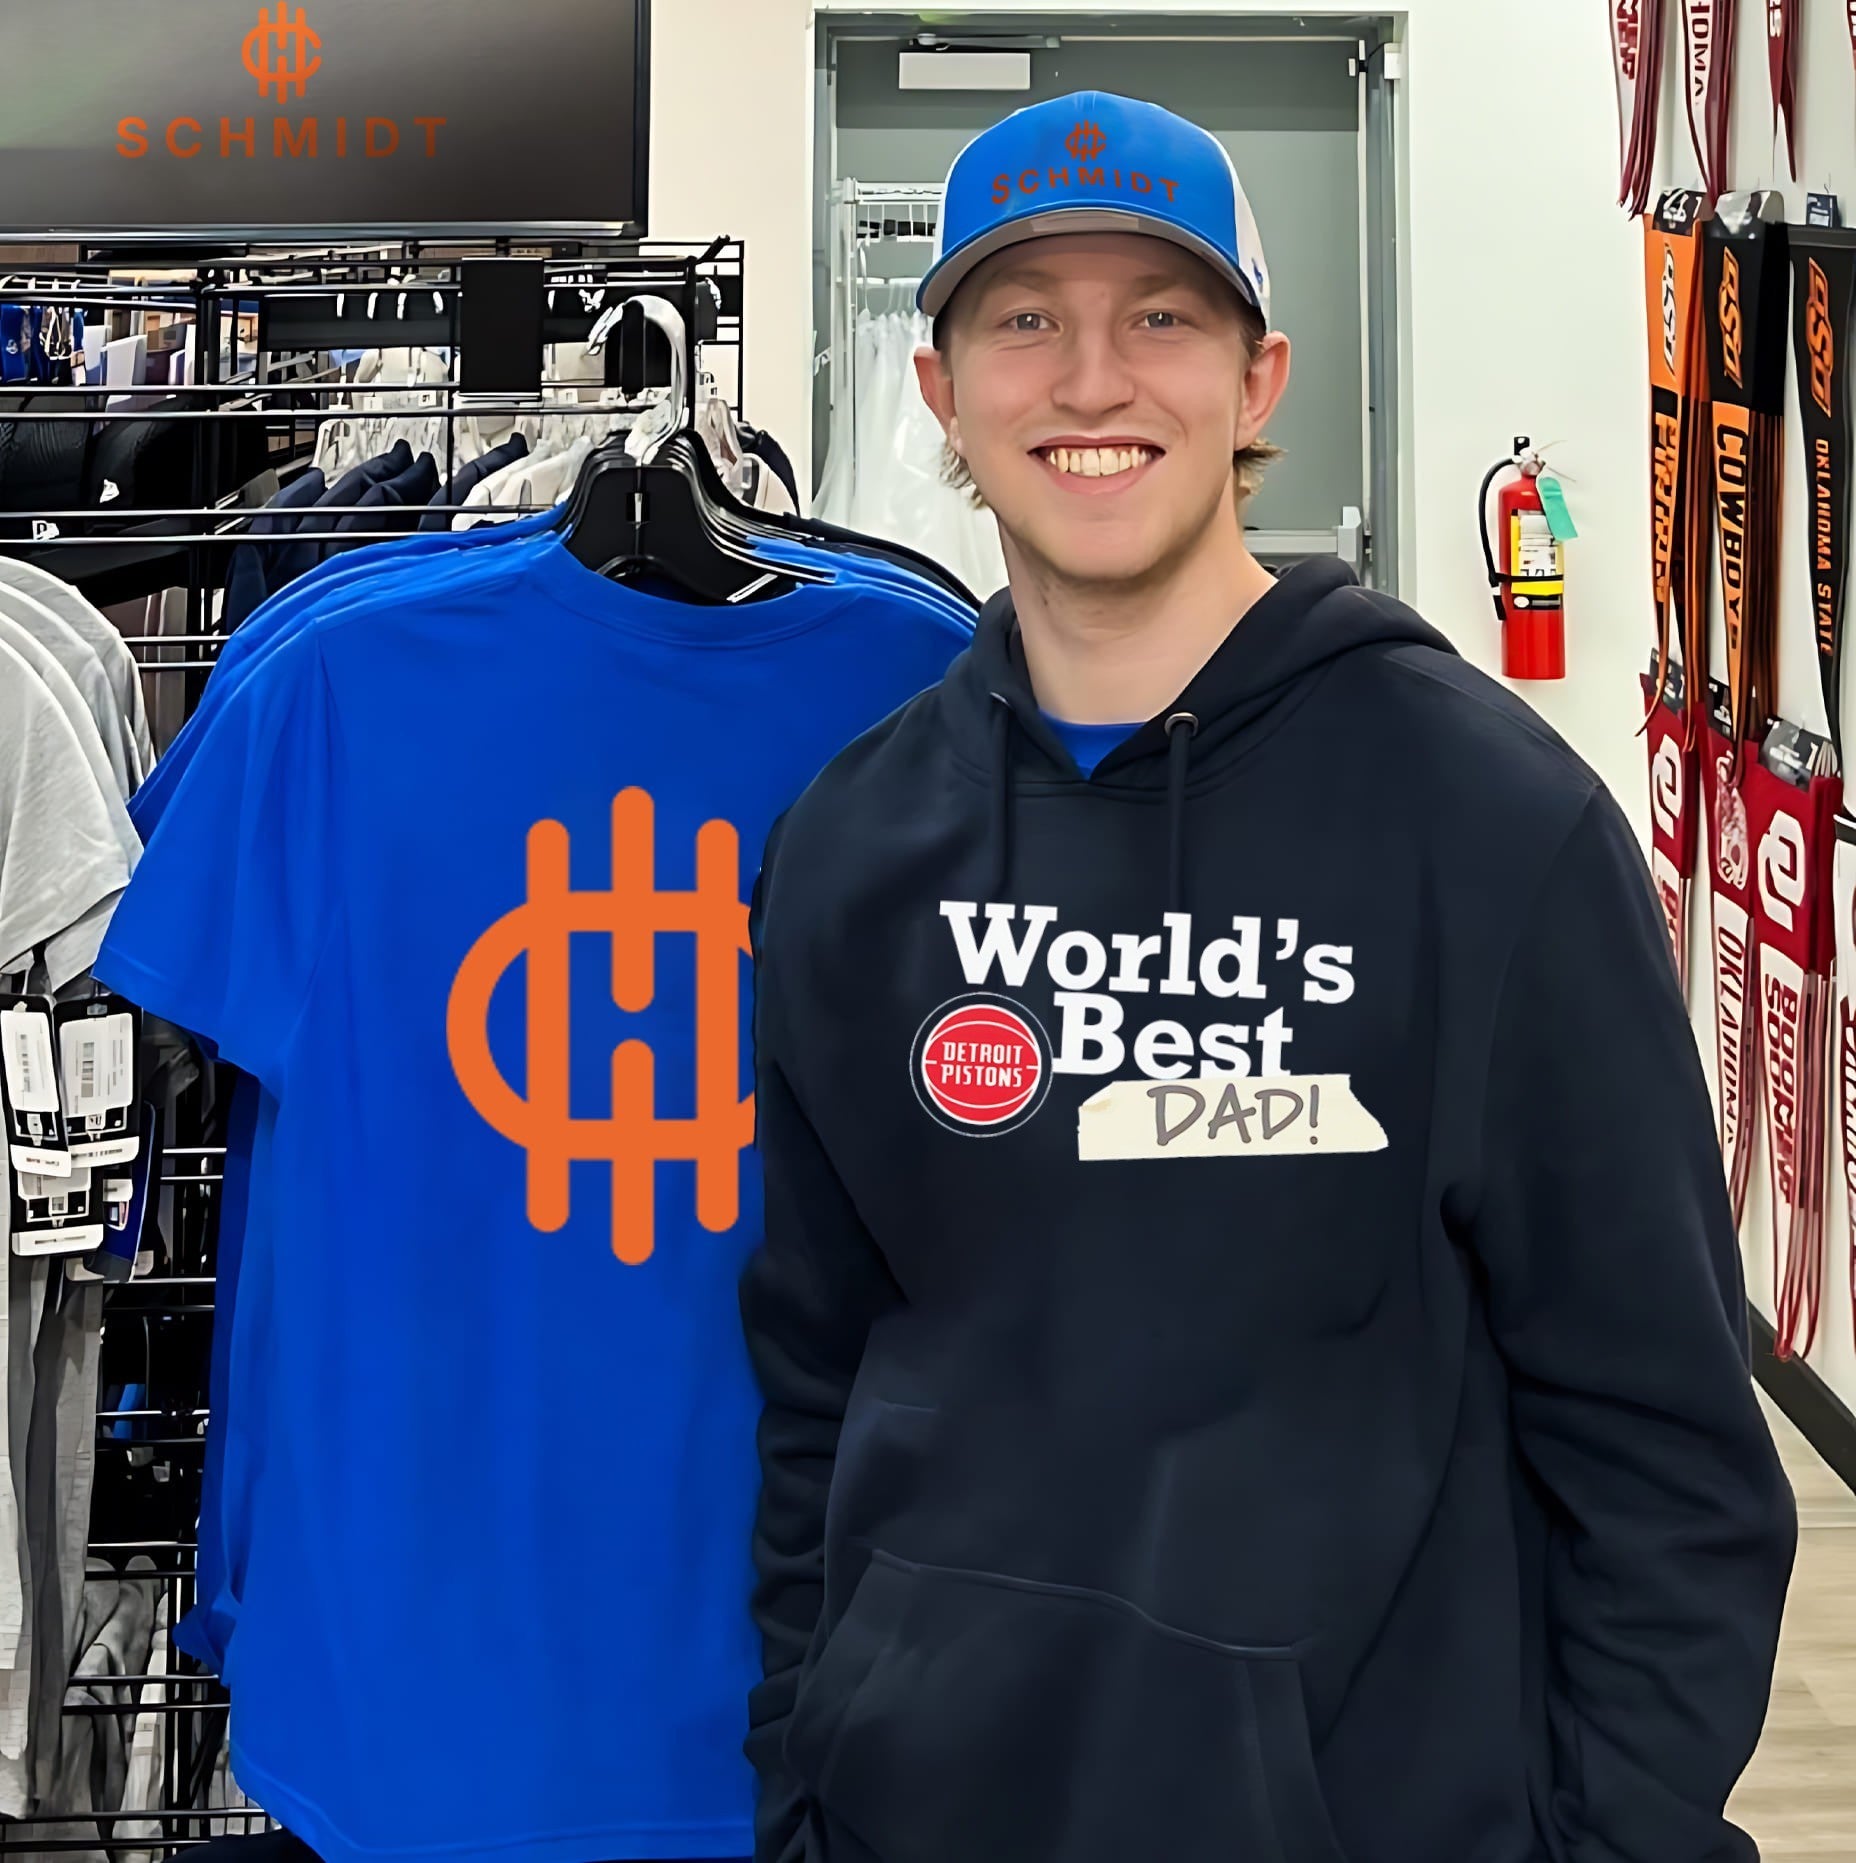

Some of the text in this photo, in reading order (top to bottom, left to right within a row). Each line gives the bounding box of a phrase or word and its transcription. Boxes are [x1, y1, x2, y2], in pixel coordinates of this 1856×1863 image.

[1691, 0, 1710, 97] OMA
[116, 117, 447, 159] SCHMIDT
[991, 167, 1179, 205] SCHMIDT
[1815, 438, 1834, 657] OKLAHOMA STATE
[940, 900, 1355, 1005] World's
[942, 1041, 1023, 1065] DETROIT
[1053, 991, 1293, 1080] Best
[1718, 926, 1745, 1144] OKLAHOMA
[941, 1063, 1022, 1088] PISTONS
[1147, 1083, 1320, 1146] DAD!
